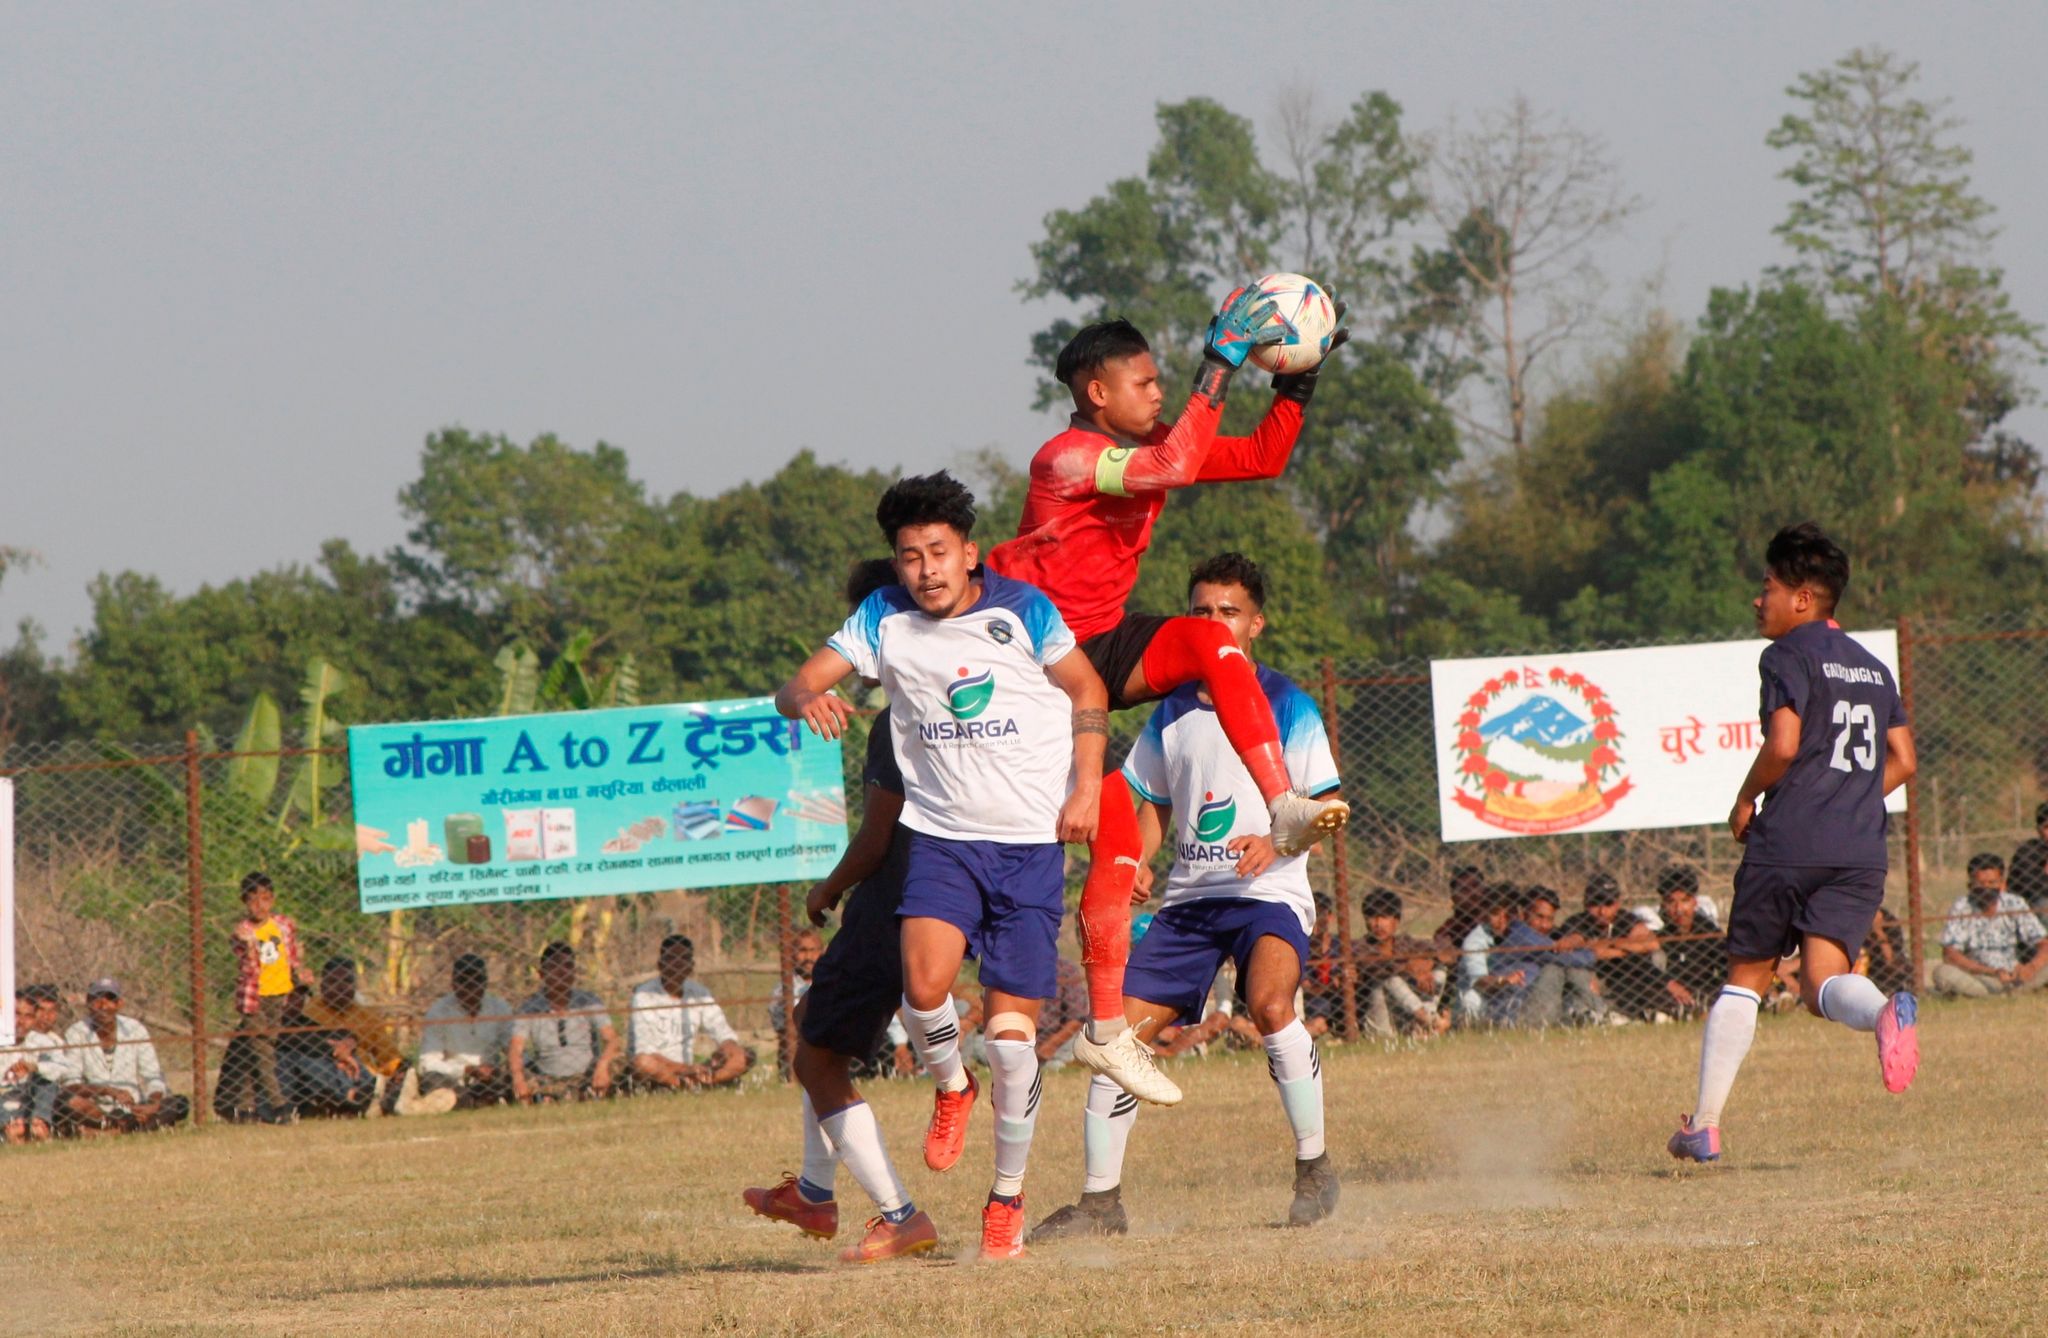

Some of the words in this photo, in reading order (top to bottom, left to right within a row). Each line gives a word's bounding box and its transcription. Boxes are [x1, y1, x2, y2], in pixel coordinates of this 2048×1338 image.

[380, 731, 487, 779] गंगा
[502, 729, 549, 774] A
[559, 731, 610, 769] to
[627, 720, 664, 765] Z
[919, 718, 1019, 741] NISARGA
[1659, 716, 1705, 764] चुरे
[1829, 699, 1876, 773] 23
[1180, 843, 1241, 862] NISARG
